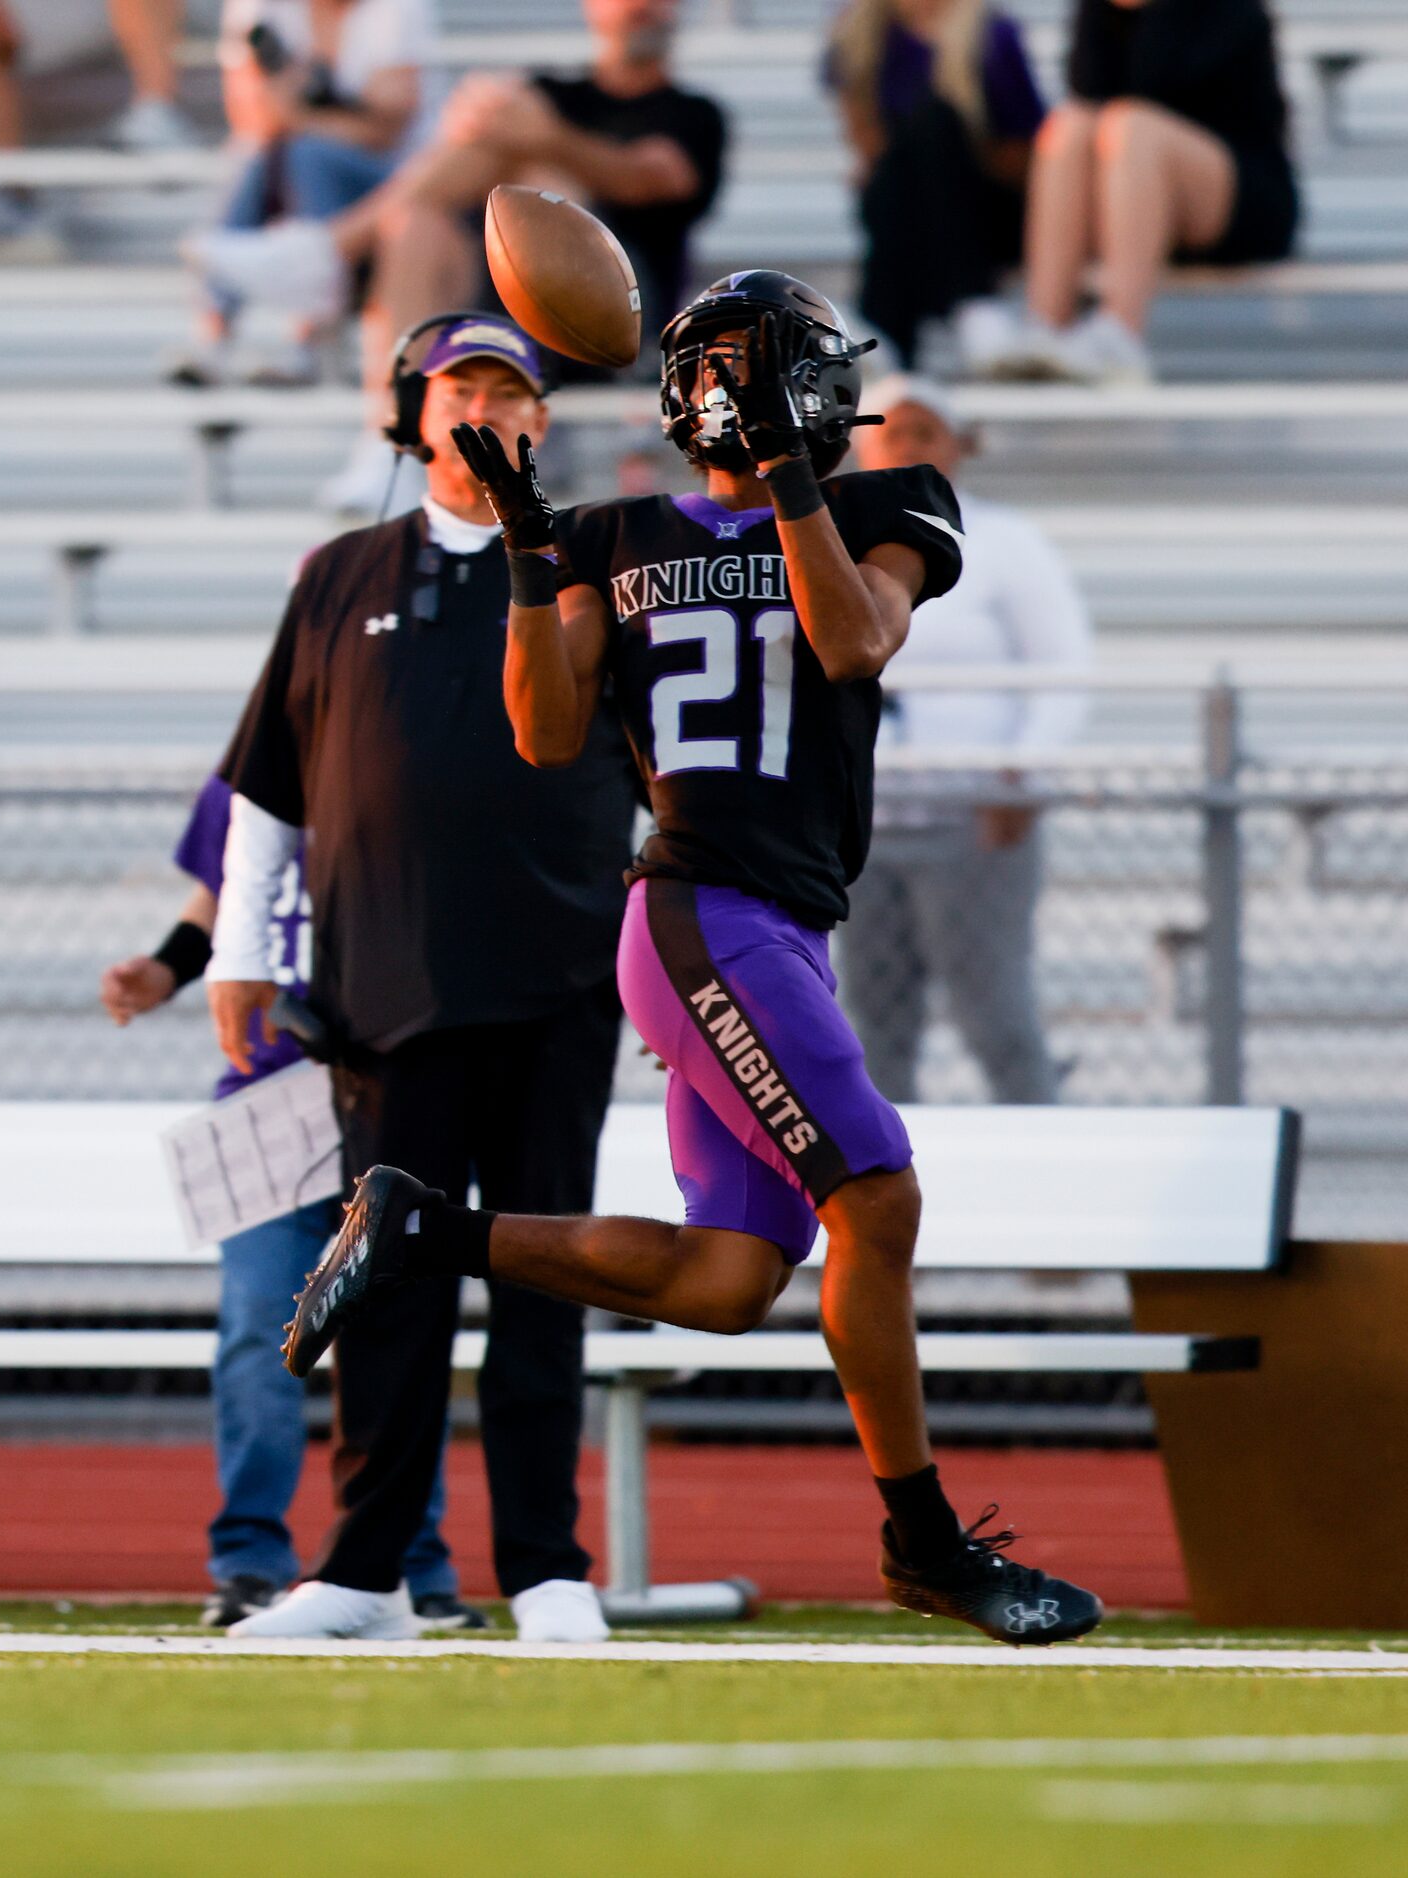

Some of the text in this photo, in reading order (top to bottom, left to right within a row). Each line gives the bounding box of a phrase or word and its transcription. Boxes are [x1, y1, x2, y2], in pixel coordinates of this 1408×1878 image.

[610, 553, 789, 624] KNIGH
[645, 604, 796, 782] 21
[689, 978, 819, 1156] KNIGHTS
